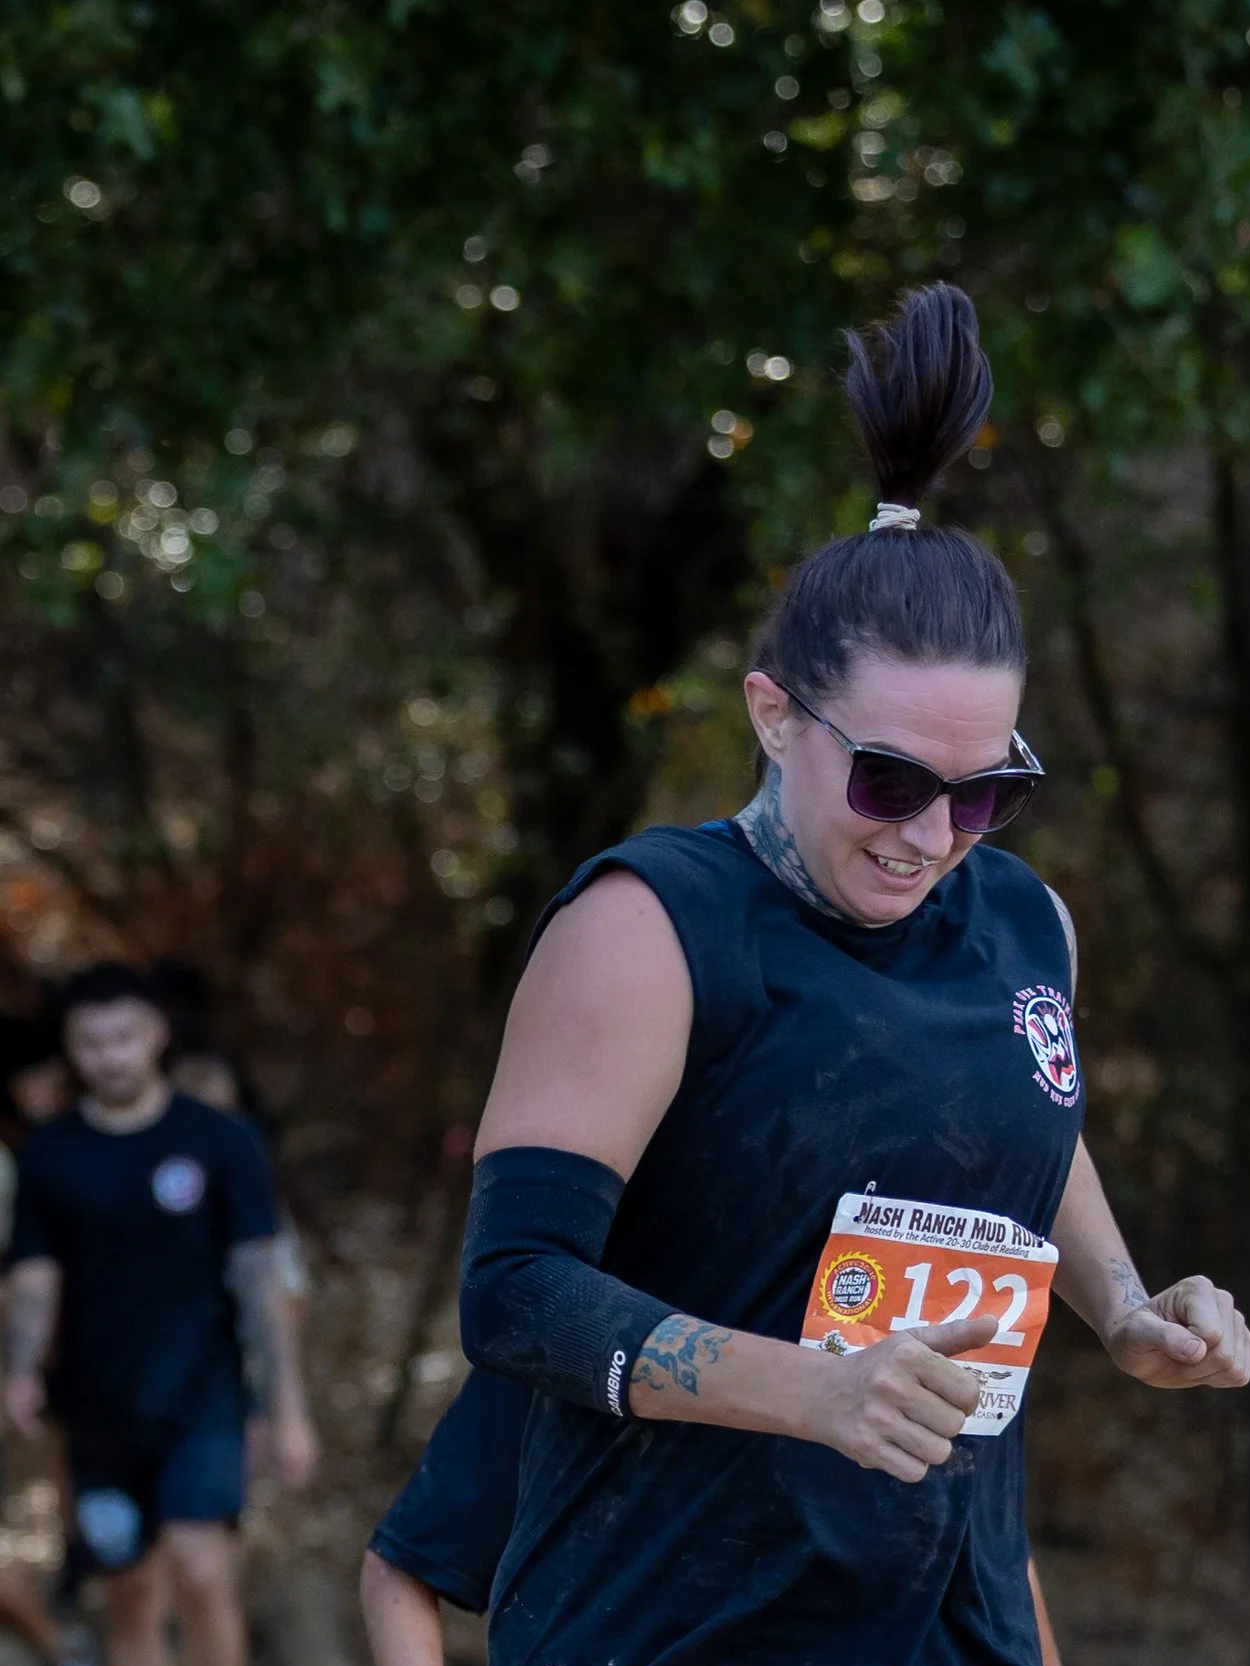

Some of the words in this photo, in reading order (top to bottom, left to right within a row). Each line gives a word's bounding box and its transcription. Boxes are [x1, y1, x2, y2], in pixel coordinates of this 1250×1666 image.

[859, 1202, 904, 1228] NASH
[908, 1209, 967, 1237] RANCH
[970, 1217, 1006, 1243] MUD
[864, 1226, 892, 1237] hosted
[894, 1229, 905, 1239] by
[905, 1232, 919, 1241] the
[920, 1233, 945, 1245] Active
[945, 1237, 971, 1249] 20-30
[972, 1241, 989, 1251] Club
[990, 1244, 1000, 1254] of
[999, 1245, 1030, 1258] Redding
[835, 1285, 865, 1295] RANCH
[838, 1274, 868, 1286] NASH
[889, 1262, 1028, 1347] 122
[607, 1350, 627, 1417] CAMBIVO
[977, 1411, 1003, 1420] CASIN
